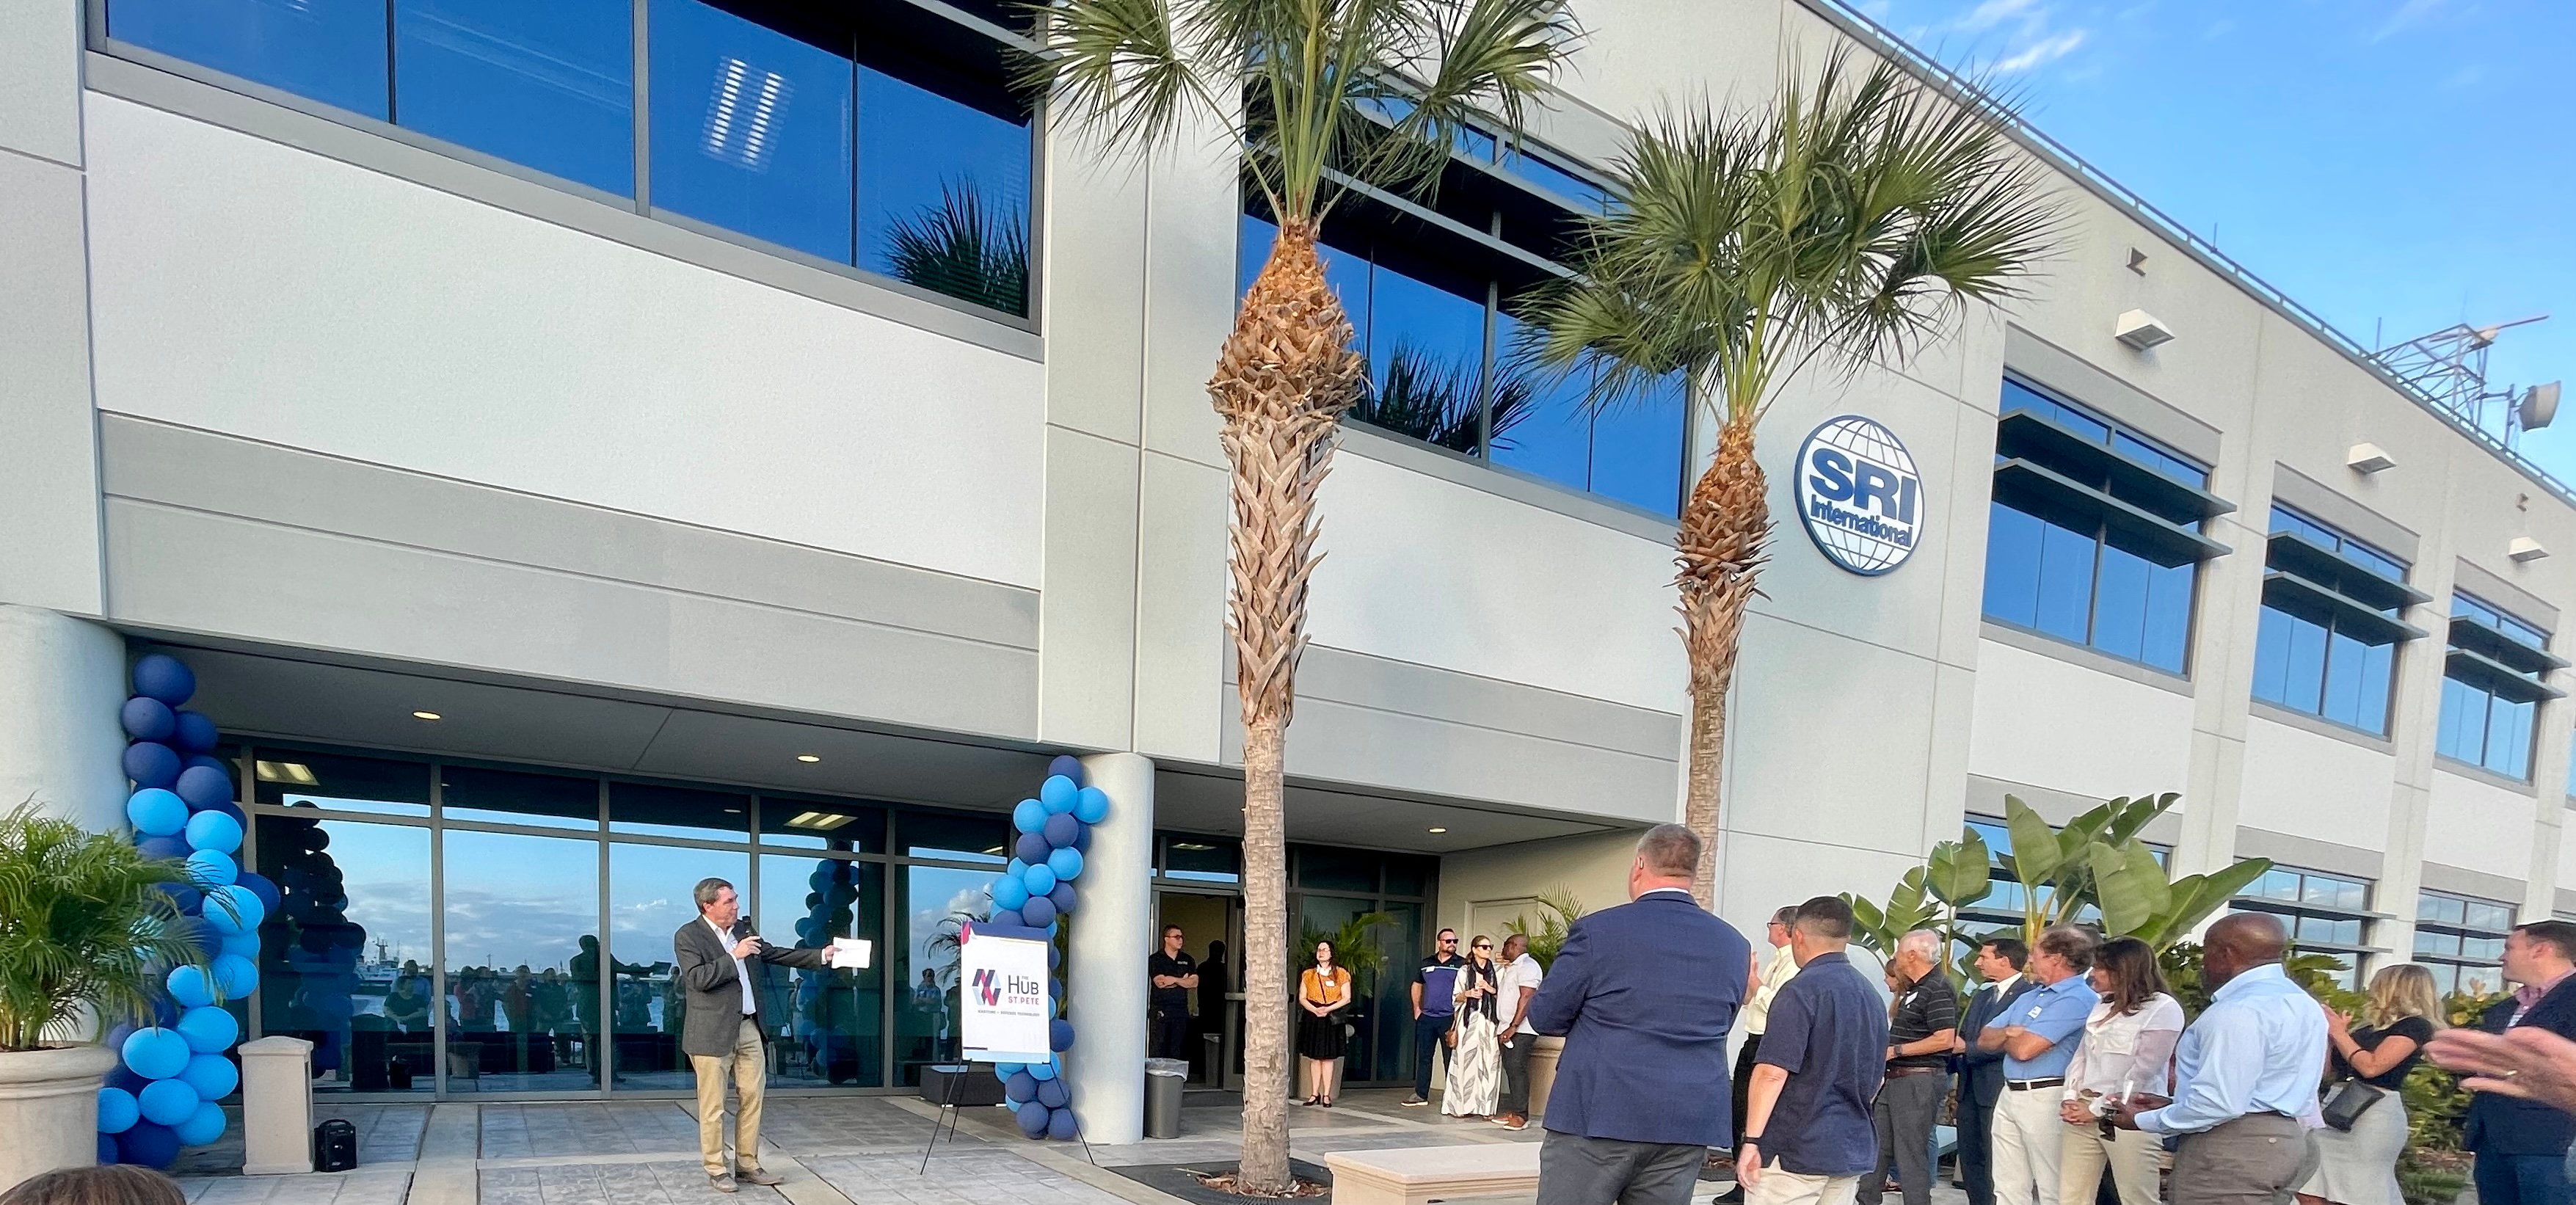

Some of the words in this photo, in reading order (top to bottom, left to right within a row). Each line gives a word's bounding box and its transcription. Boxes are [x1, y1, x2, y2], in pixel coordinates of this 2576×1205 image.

[1809, 448, 1917, 525] SRI
[1811, 494, 1913, 547] International
[1008, 975, 1039, 994] HUB
